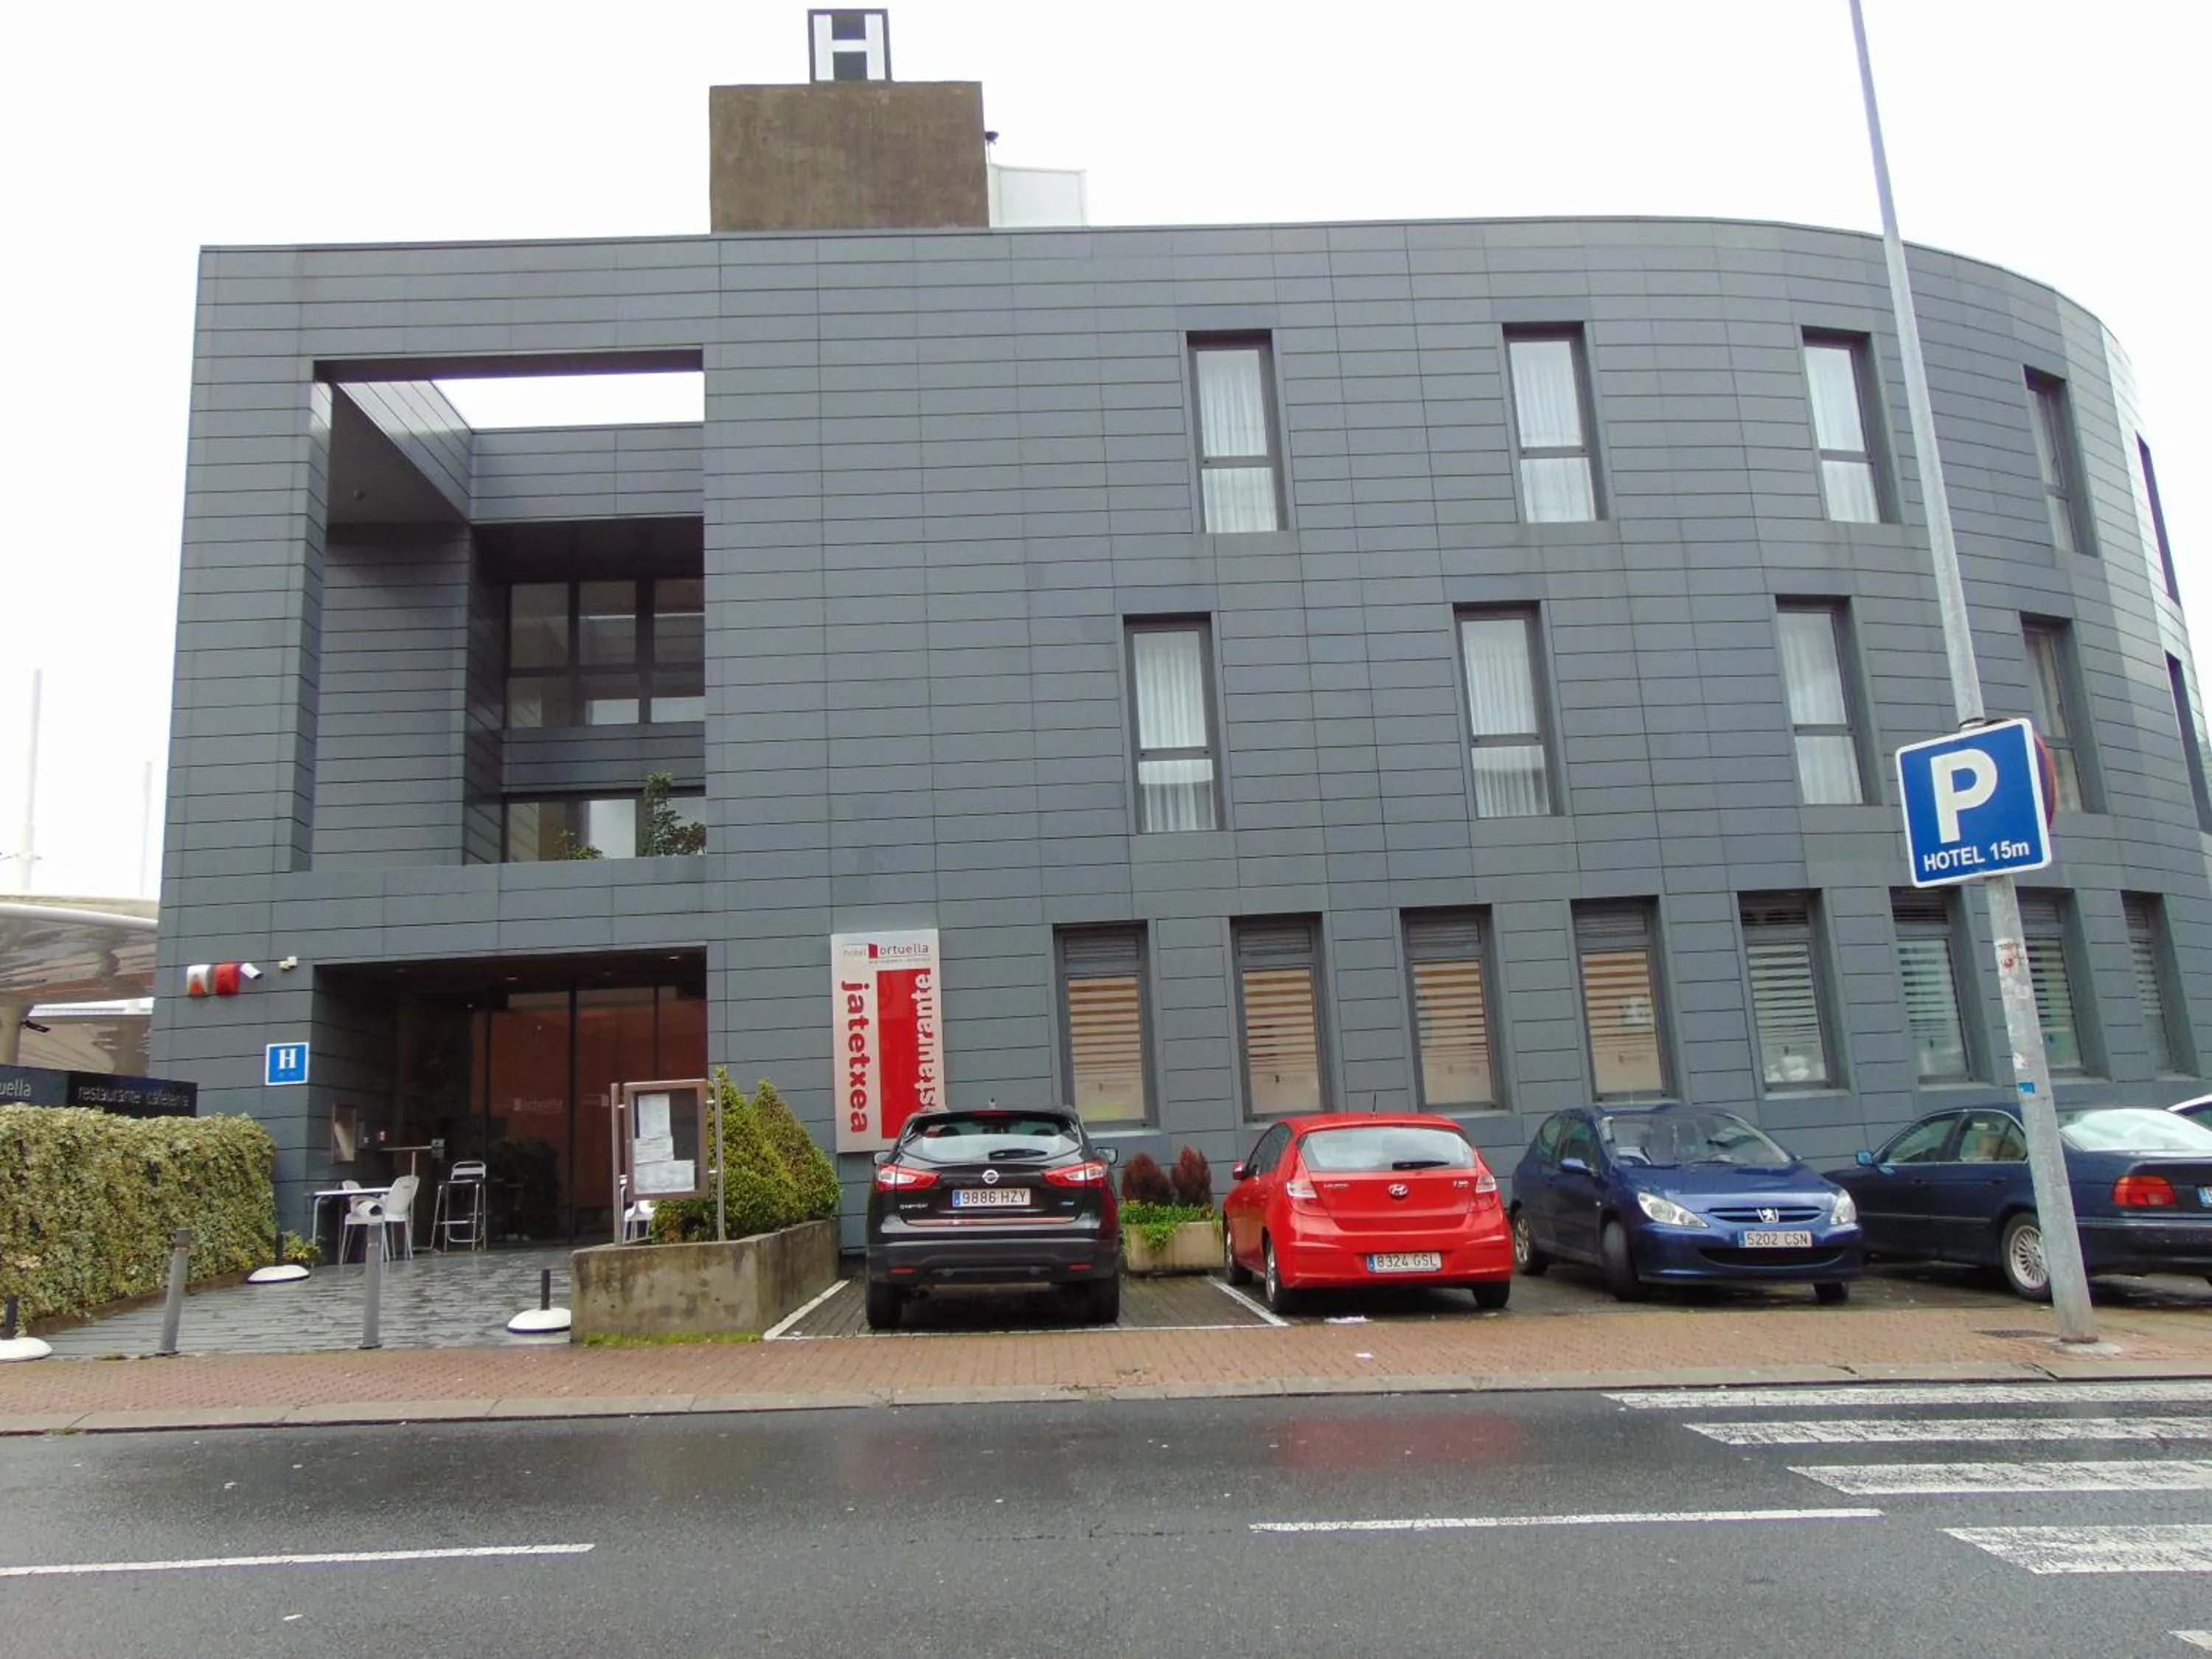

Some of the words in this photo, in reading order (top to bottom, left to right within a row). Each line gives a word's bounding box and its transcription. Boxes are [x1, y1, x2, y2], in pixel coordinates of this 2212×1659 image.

[813, 13, 886, 80] H
[1930, 748, 1997, 844] P
[1923, 846, 1986, 872] HOTEL
[1989, 840, 2030, 861] 15m
[279, 1048, 298, 1070] H
[841, 980, 871, 1133] jatetxea
[911, 973, 936, 1113] staurante
[962, 1190, 996, 1205] 9886
[1001, 1189, 1028, 1203] HZY
[1746, 1232, 1779, 1246] 5202
[1784, 1231, 1809, 1245] CSN
[1377, 1254, 1409, 1268] 8324
[1413, 1253, 1437, 1267] GSL
